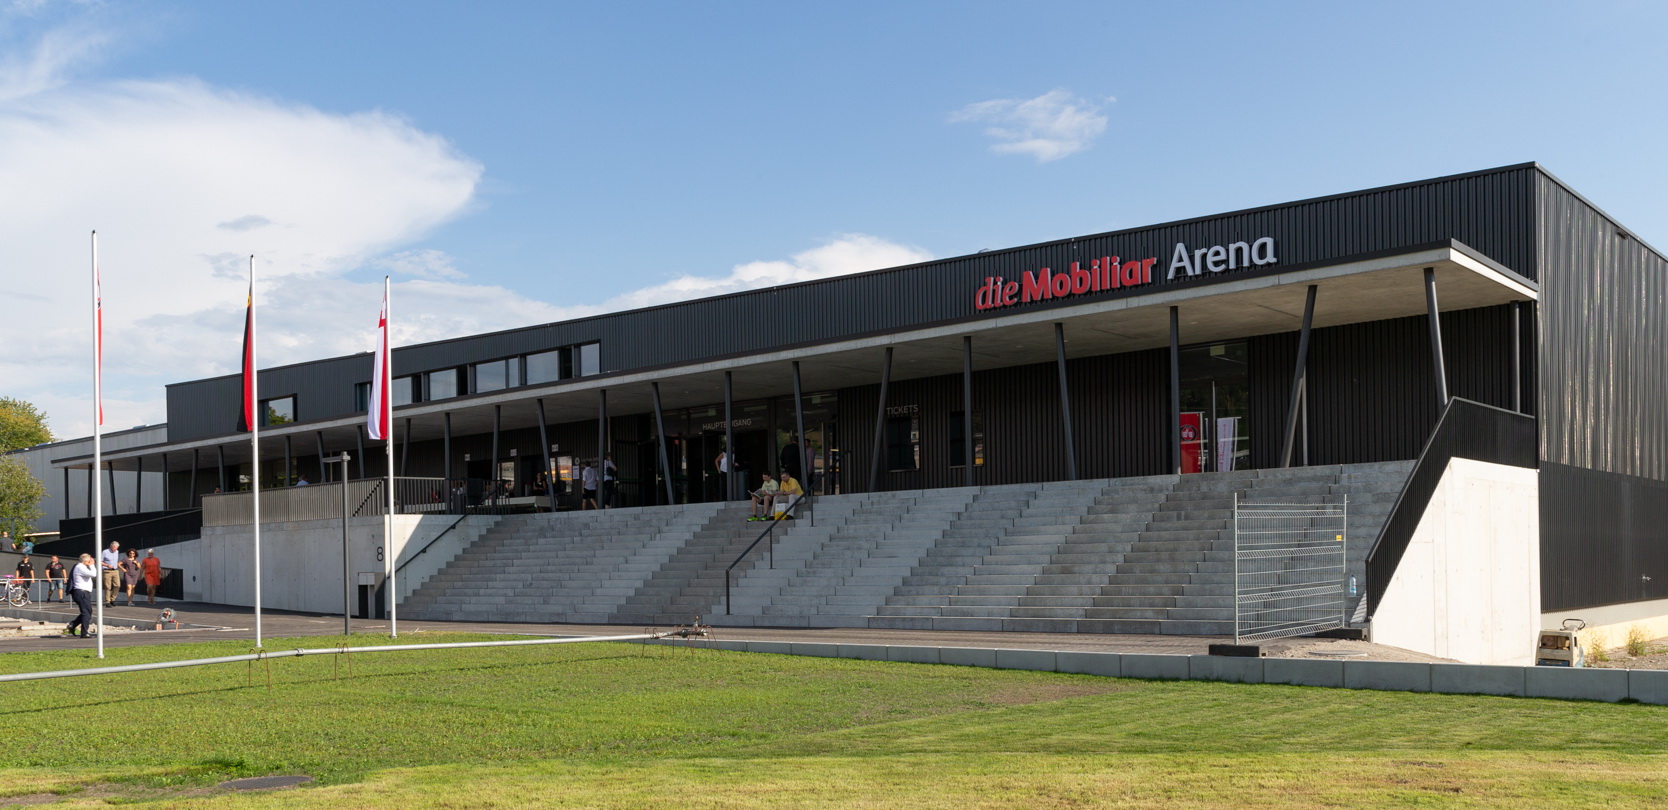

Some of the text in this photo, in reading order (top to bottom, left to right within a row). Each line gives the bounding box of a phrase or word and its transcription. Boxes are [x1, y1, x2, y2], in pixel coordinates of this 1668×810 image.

[1167, 236, 1278, 280] Arena
[886, 404, 919, 415] TICKETS
[702, 418, 752, 430] HAUPTEGANG
[376, 546, 384, 562] 8
